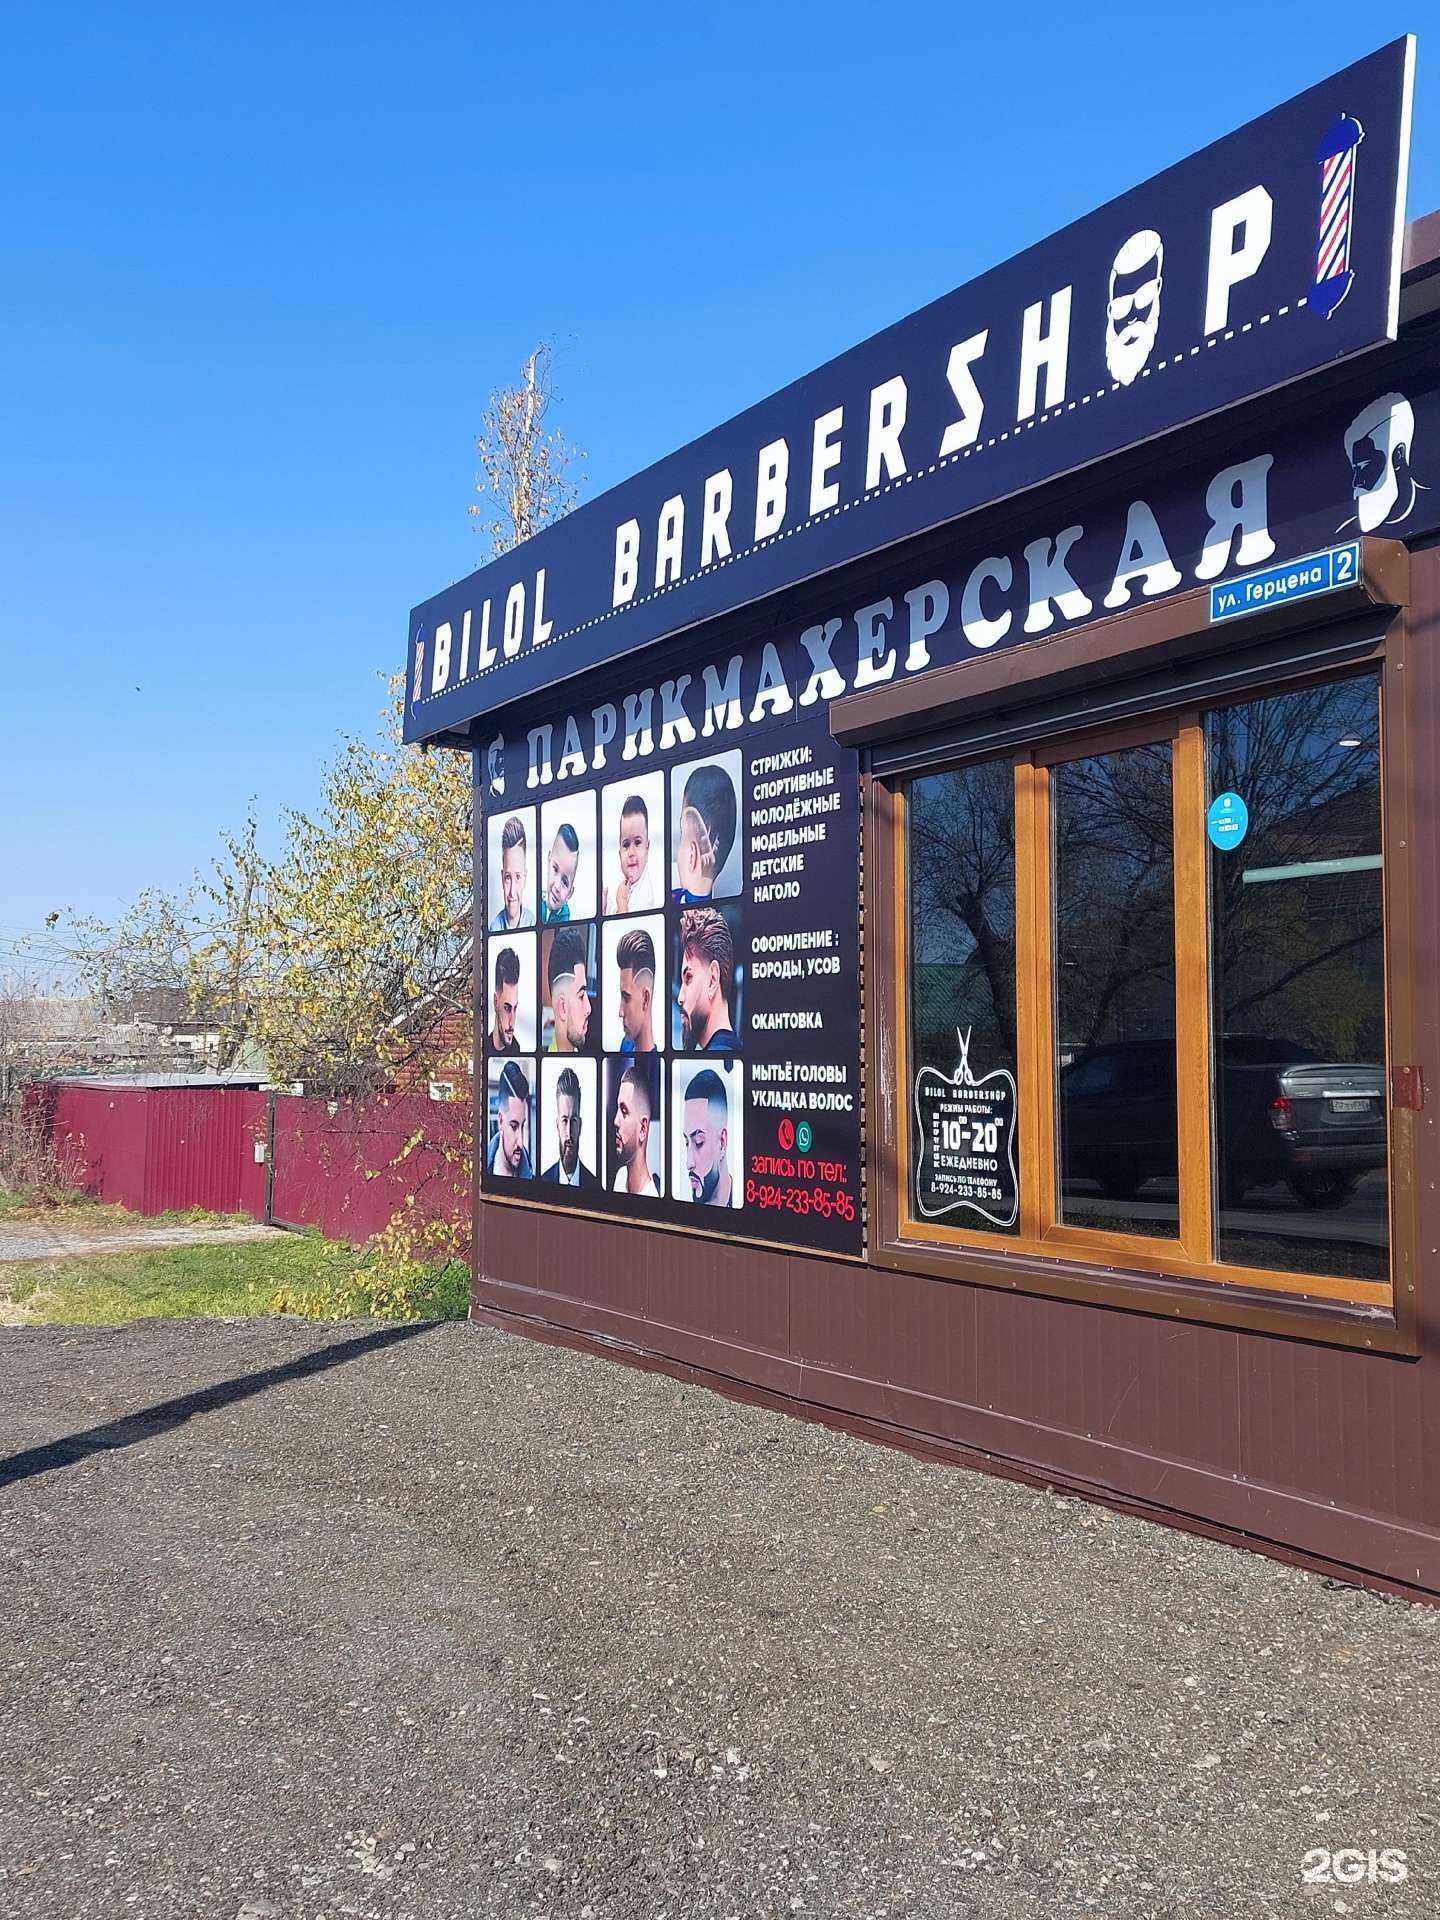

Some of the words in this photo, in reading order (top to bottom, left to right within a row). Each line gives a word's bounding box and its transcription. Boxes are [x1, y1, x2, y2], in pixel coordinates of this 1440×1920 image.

[1218, 595, 1241, 613] ул.
[1246, 567, 1322, 601] Герцена
[1337, 551, 1352, 581] 2
[431, 568, 554, 694] BILOL
[526, 454, 1277, 789] ПАРИКМАХЕРСКАЯ
[751, 746, 813, 776] СТРИЖКИ:
[753, 767, 834, 801] СПОРТИВНЫЕ
[751, 793, 840, 827] МОЛОДЁЖНЫЕ
[751, 823, 826, 852] МОДЕЛЬНЫЕ
[751, 854, 804, 880] ДЕТСКИЕ
[753, 881, 800, 903] НАГОЛО
[752, 960, 805, 979] БОРОДЫ,
[807, 956, 840, 976] УСОВ
[751, 1012, 823, 1030] ОКАНТОВКА
[752, 1061, 792, 1081] МЫТЬЁ
[794, 1065, 847, 1083] ГОЛОВЫ
[752, 1090, 807, 1111] УКЛАДКА
[809, 1093, 853, 1111] ВОЛОС
[940, 1104, 963, 1113] РЕЖИМ
[964, 1105, 993, 1114] РАБОТЫ:
[798, 1160, 815, 1179] по
[940, 1154, 998, 1171] ЕЖЕДНЕВНО
[930, 1181, 1003, 1201] 8-924-233-85-85
[934, 1173, 957, 1183] ЗАПИСЬ
[957, 1175, 967, 1184] ПО
[967, 1176, 998, 1187] ТЕЛЕФОНУ
[746, 1179, 855, 1221] 8-924-233-85-85
